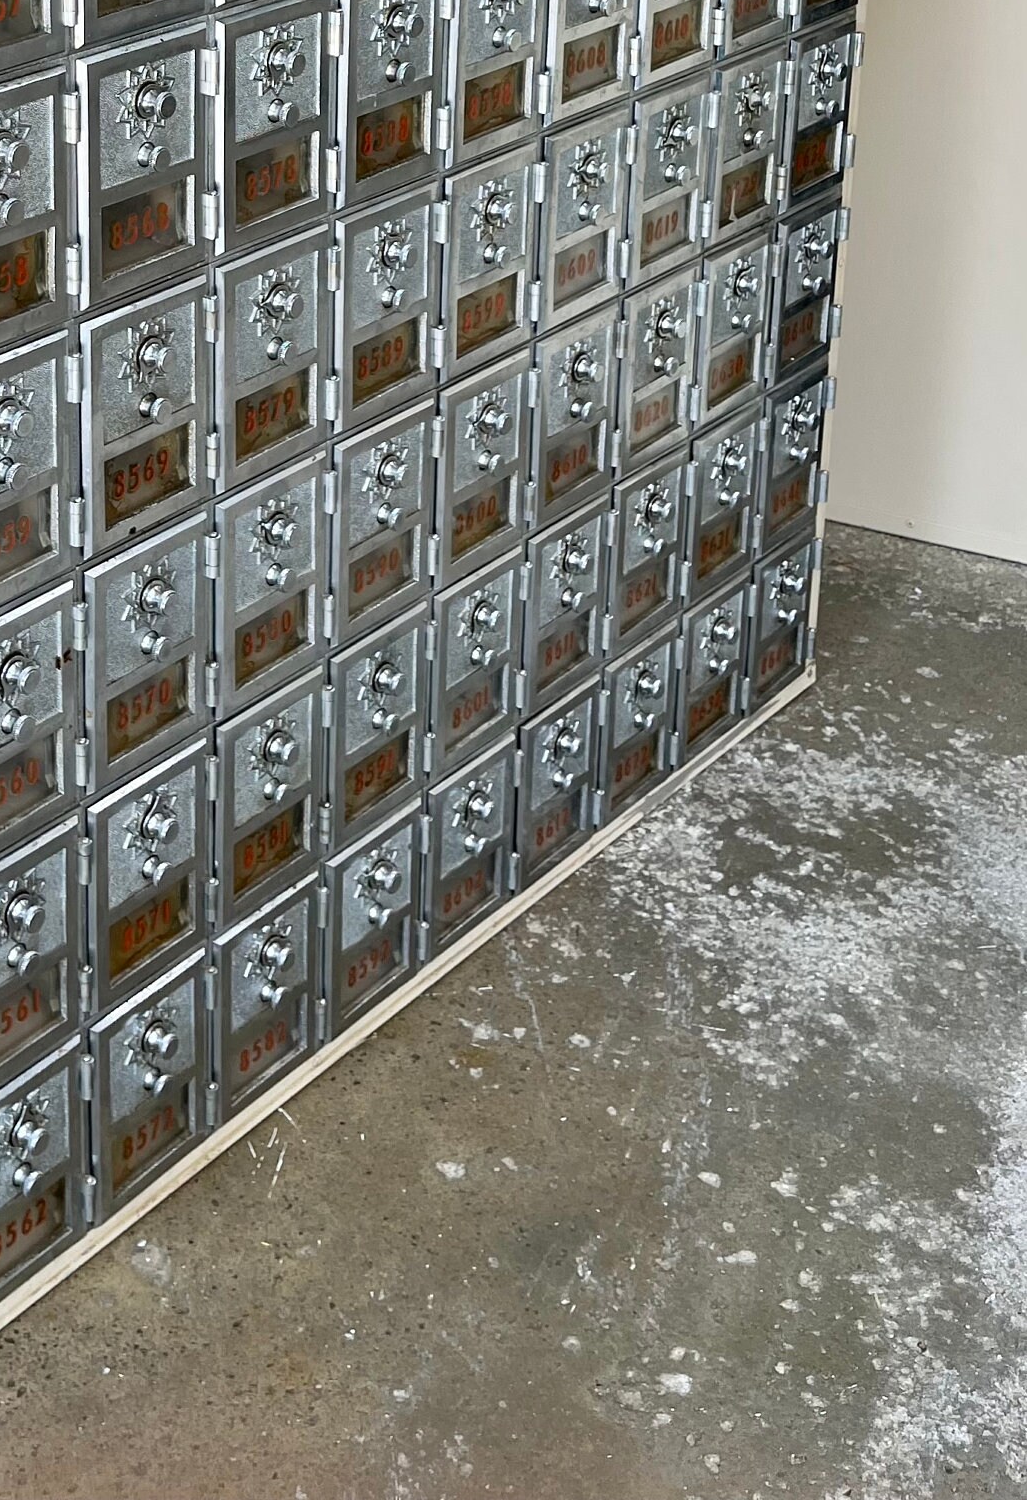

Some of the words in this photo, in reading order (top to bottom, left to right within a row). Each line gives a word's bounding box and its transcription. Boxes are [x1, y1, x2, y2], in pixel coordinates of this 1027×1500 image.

[567, 40, 607, 79] 8608
[467, 80, 512, 120] 8598
[361, 114, 410, 156] 8588
[247, 157, 297, 201] 8578
[112, 204, 170, 250] 8568
[559, 249, 596, 286] 8609
[462, 293, 505, 334] 8599
[358, 339, 405, 382] 8589
[243, 389, 296, 436] 8579
[114, 450, 170, 500] 8569
[551, 444, 588, 483] 8610
[354, 548, 400, 594] 8590
[117, 680, 173, 732] 8570
[452, 686, 491, 729] 8601
[354, 748, 395, 795] 8591
[243, 821, 289, 872] 8581
[536, 808, 570, 847] 8612
[442, 870, 484, 914] 8602
[239, 1022, 287, 1073] 8582
[123, 1107, 175, 1162] 8572
